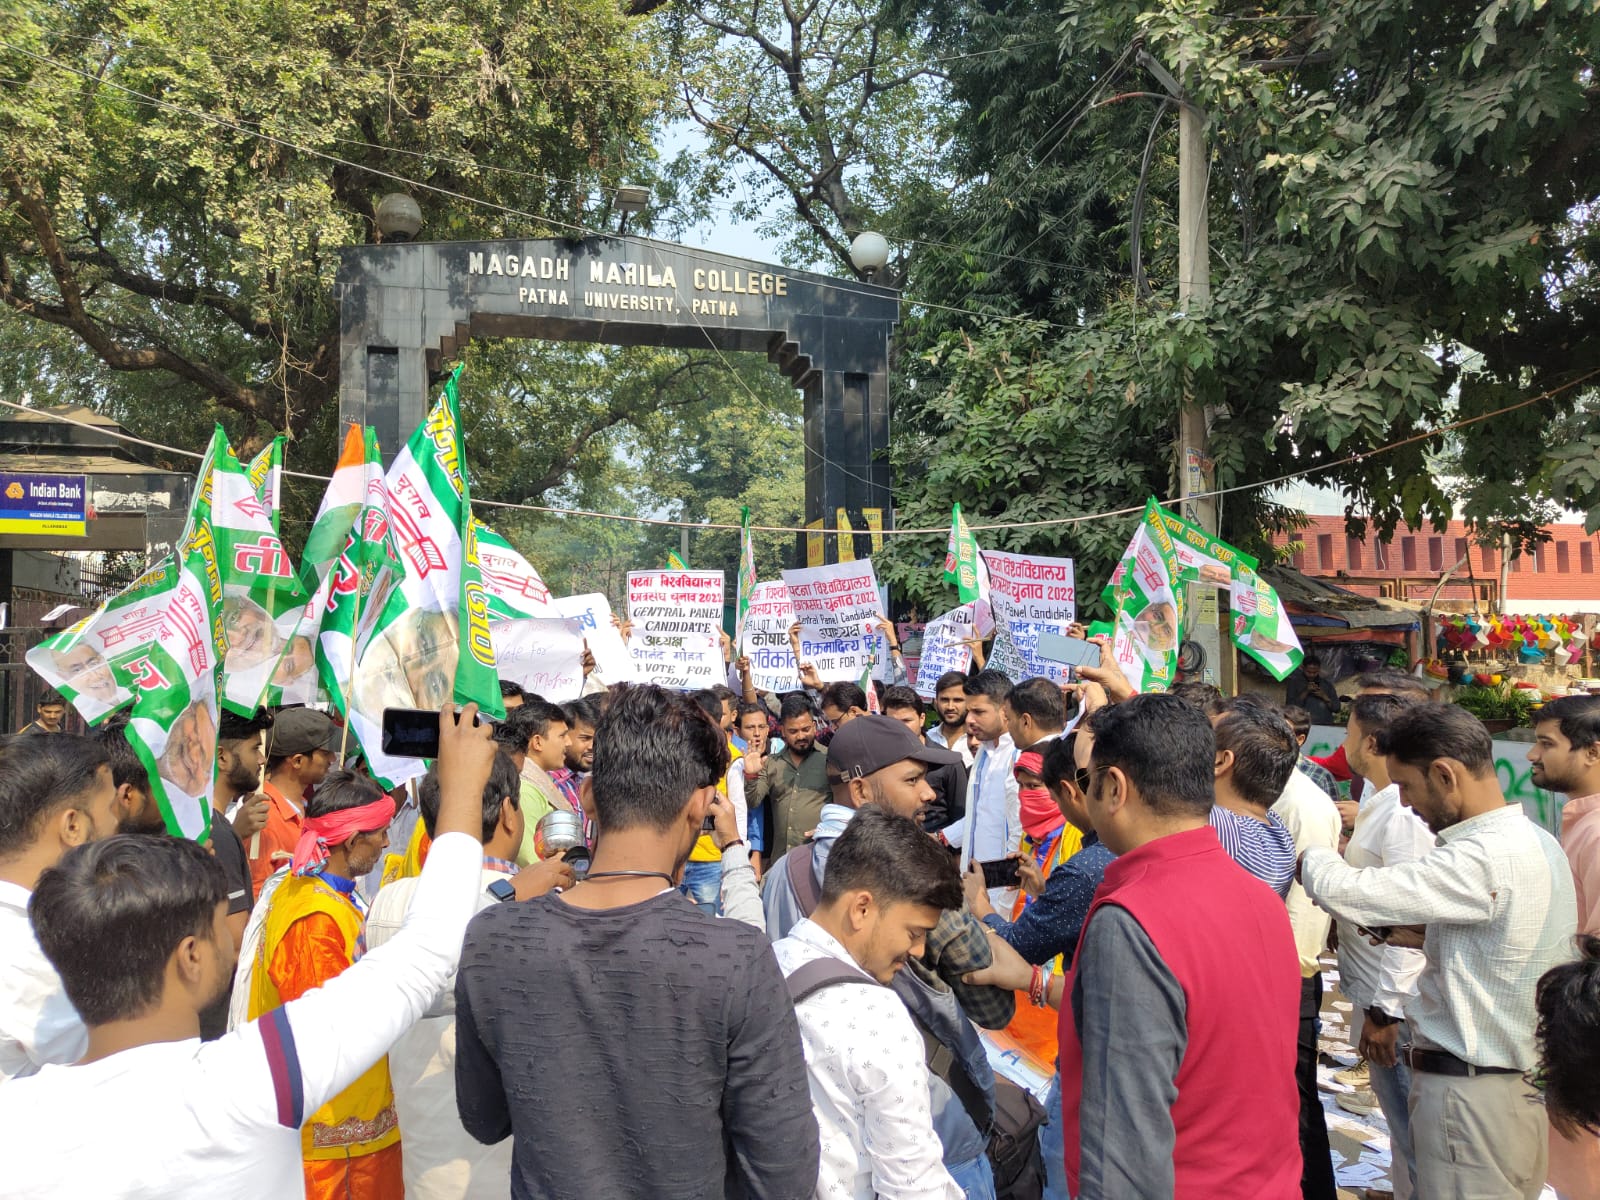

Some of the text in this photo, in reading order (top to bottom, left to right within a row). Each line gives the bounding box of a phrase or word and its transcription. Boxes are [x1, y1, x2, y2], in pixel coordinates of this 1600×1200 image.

[469, 252, 788, 296] MAGADH MAHILA COLLEGE
[519, 287, 738, 316] PATNA UNIVERSITY, PATNA
[30, 482, 81, 499] Indian Bank
[393, 474, 431, 519] चुनाव
[1004, 557, 1067, 581] विश्वविद्यालय
[788, 576, 871, 597] पटना विश्वविद्यालय
[1011, 582, 1044, 603] चुनाव
[1047, 586, 1074, 602] 2022
[824, 594, 854, 612] चुनाव
[855, 591, 876, 605] 2022
[633, 607, 721, 619] CENTRAL PANEL
[841, 608, 876, 623] Candidate
[645, 621, 711, 634] CANDIDATE
[819, 624, 860, 639] उपाध्यक्ष
[642, 635, 688, 648] अध्यक्ष
[645, 663, 712, 676] VOTE FOR
[816, 657, 835, 671] VOTE
[840, 656, 856, 668] FOR
[1062, 668, 1068, 678] 5
[752, 674, 771, 689] OTE
[773, 676, 792, 690] FOR
